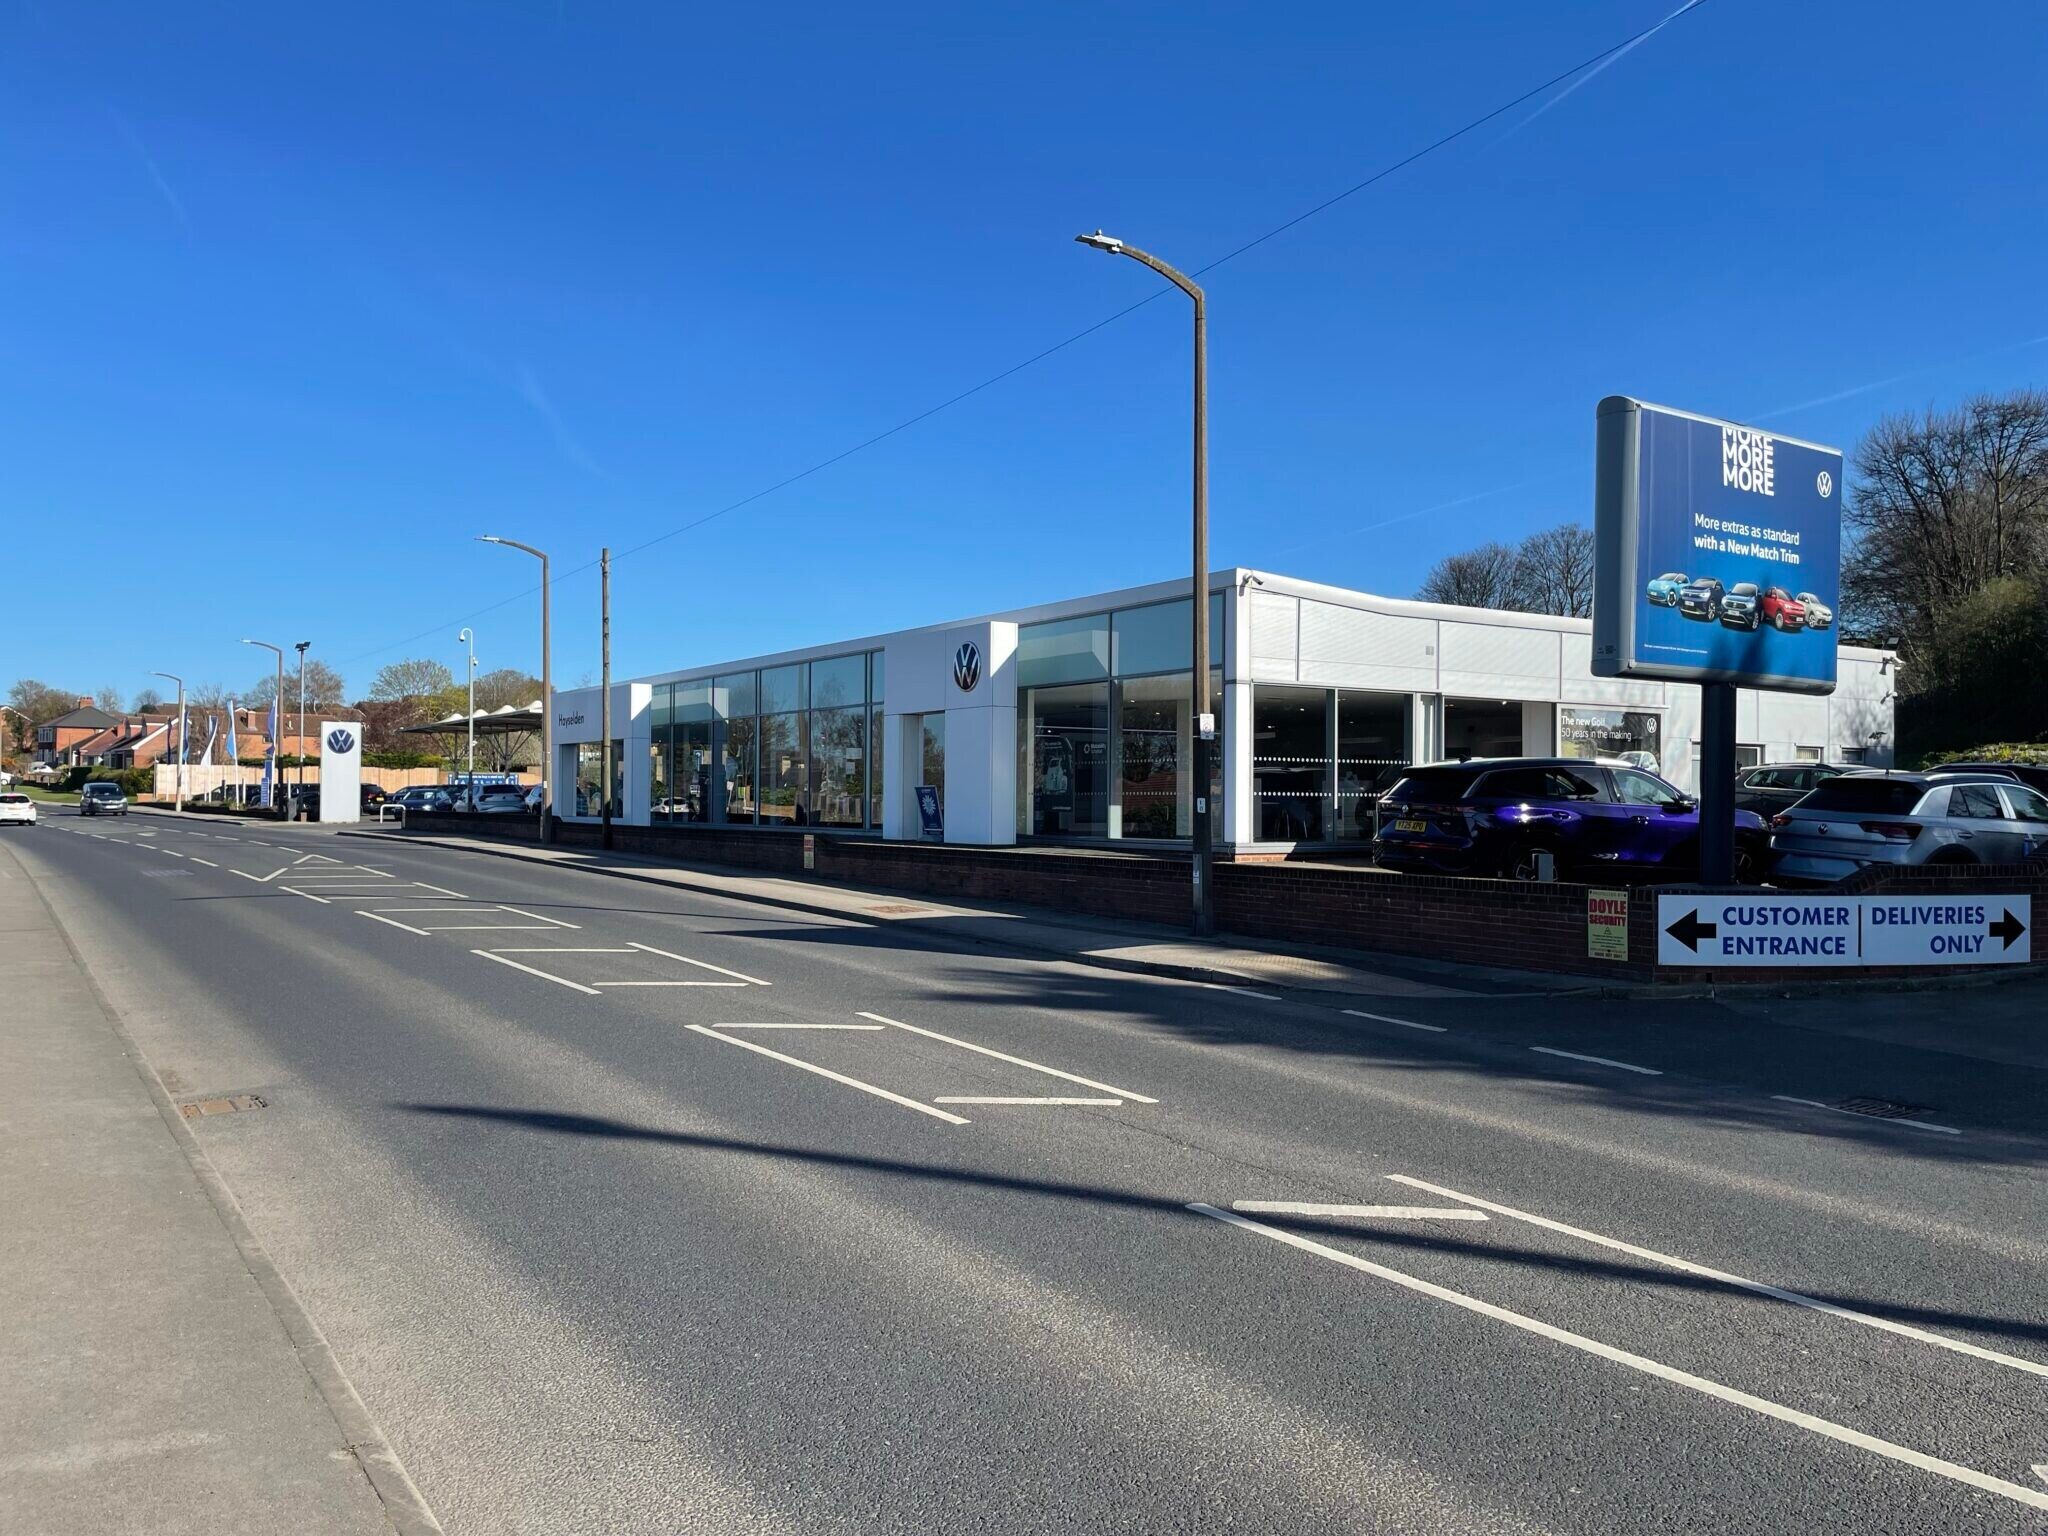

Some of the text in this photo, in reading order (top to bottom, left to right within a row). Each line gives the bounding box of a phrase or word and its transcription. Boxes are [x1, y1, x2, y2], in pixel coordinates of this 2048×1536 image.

[1722, 439, 1774, 474] MORE
[1723, 463, 1775, 497] MORE
[1695, 512, 1800, 546] More extras as standard
[1694, 534, 1800, 565] with a New Match Trim
[558, 711, 585, 729] Hayselden
[1561, 715, 1606, 729] The new Golf
[1561, 727, 1632, 742] 50 years in the making
[1589, 898, 1627, 916] DOYLE
[1722, 906, 1850, 926] CUSTOMER
[1871, 906, 1985, 925] DELIVERIES
[1590, 914, 1627, 927] SECURITY
[1722, 936, 1846, 955] ENTRANCE
[1930, 935, 1985, 954] ONLY
